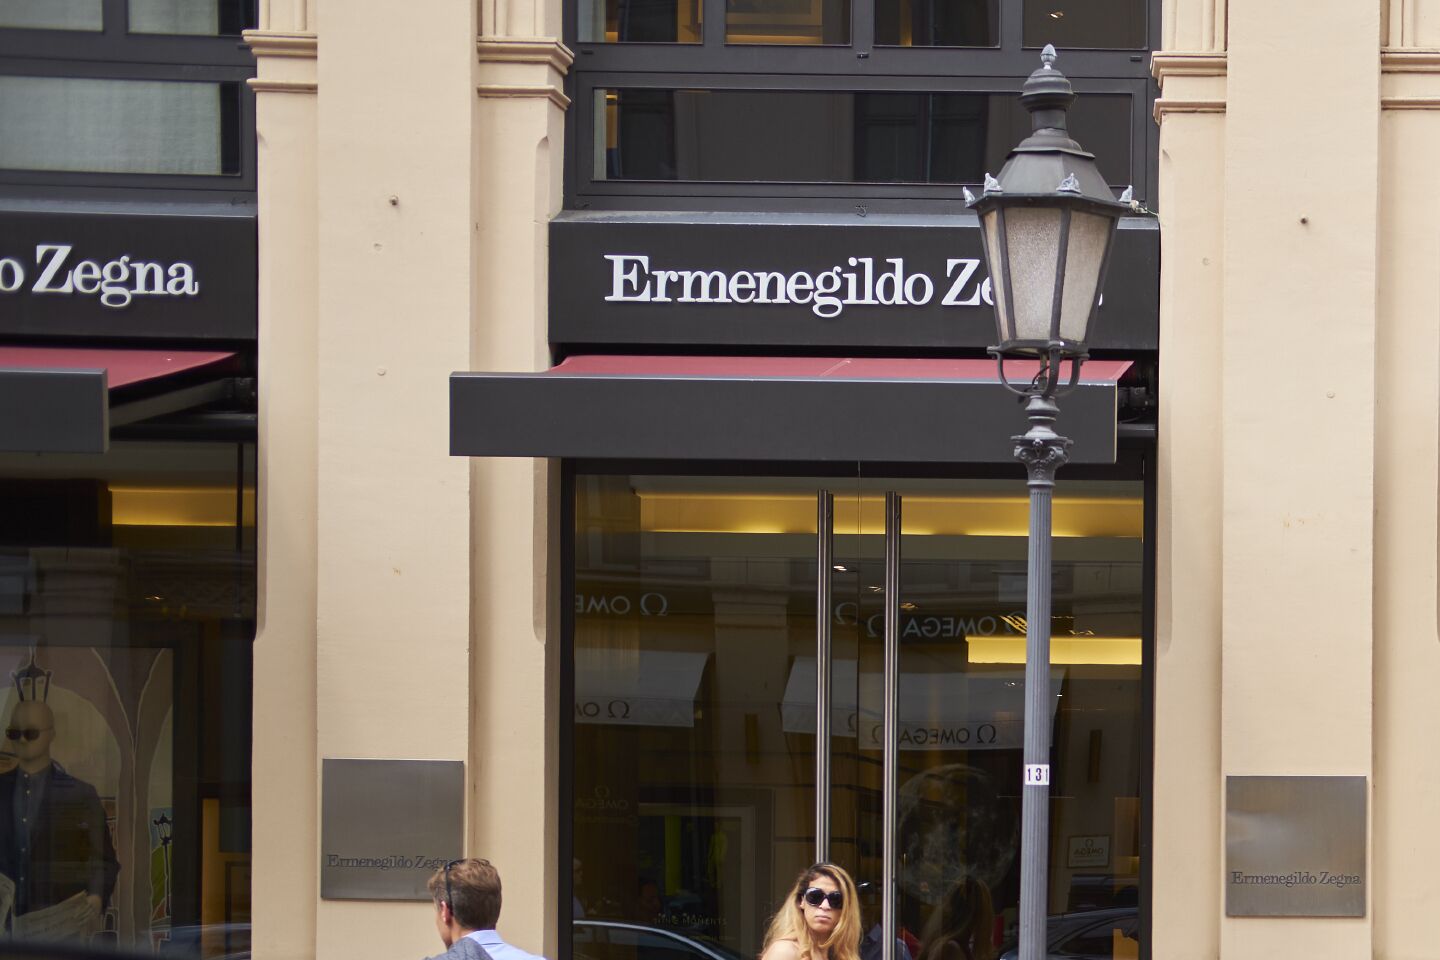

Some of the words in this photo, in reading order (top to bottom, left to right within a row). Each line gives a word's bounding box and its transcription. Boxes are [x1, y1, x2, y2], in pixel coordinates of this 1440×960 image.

[31, 244, 200, 307] Zegna
[603, 253, 934, 318] Ermenegildo
[326, 854, 413, 870] Ermenegildo
[1230, 871, 1318, 888] Ermenegildo
[1319, 872, 1361, 888] Zegna
